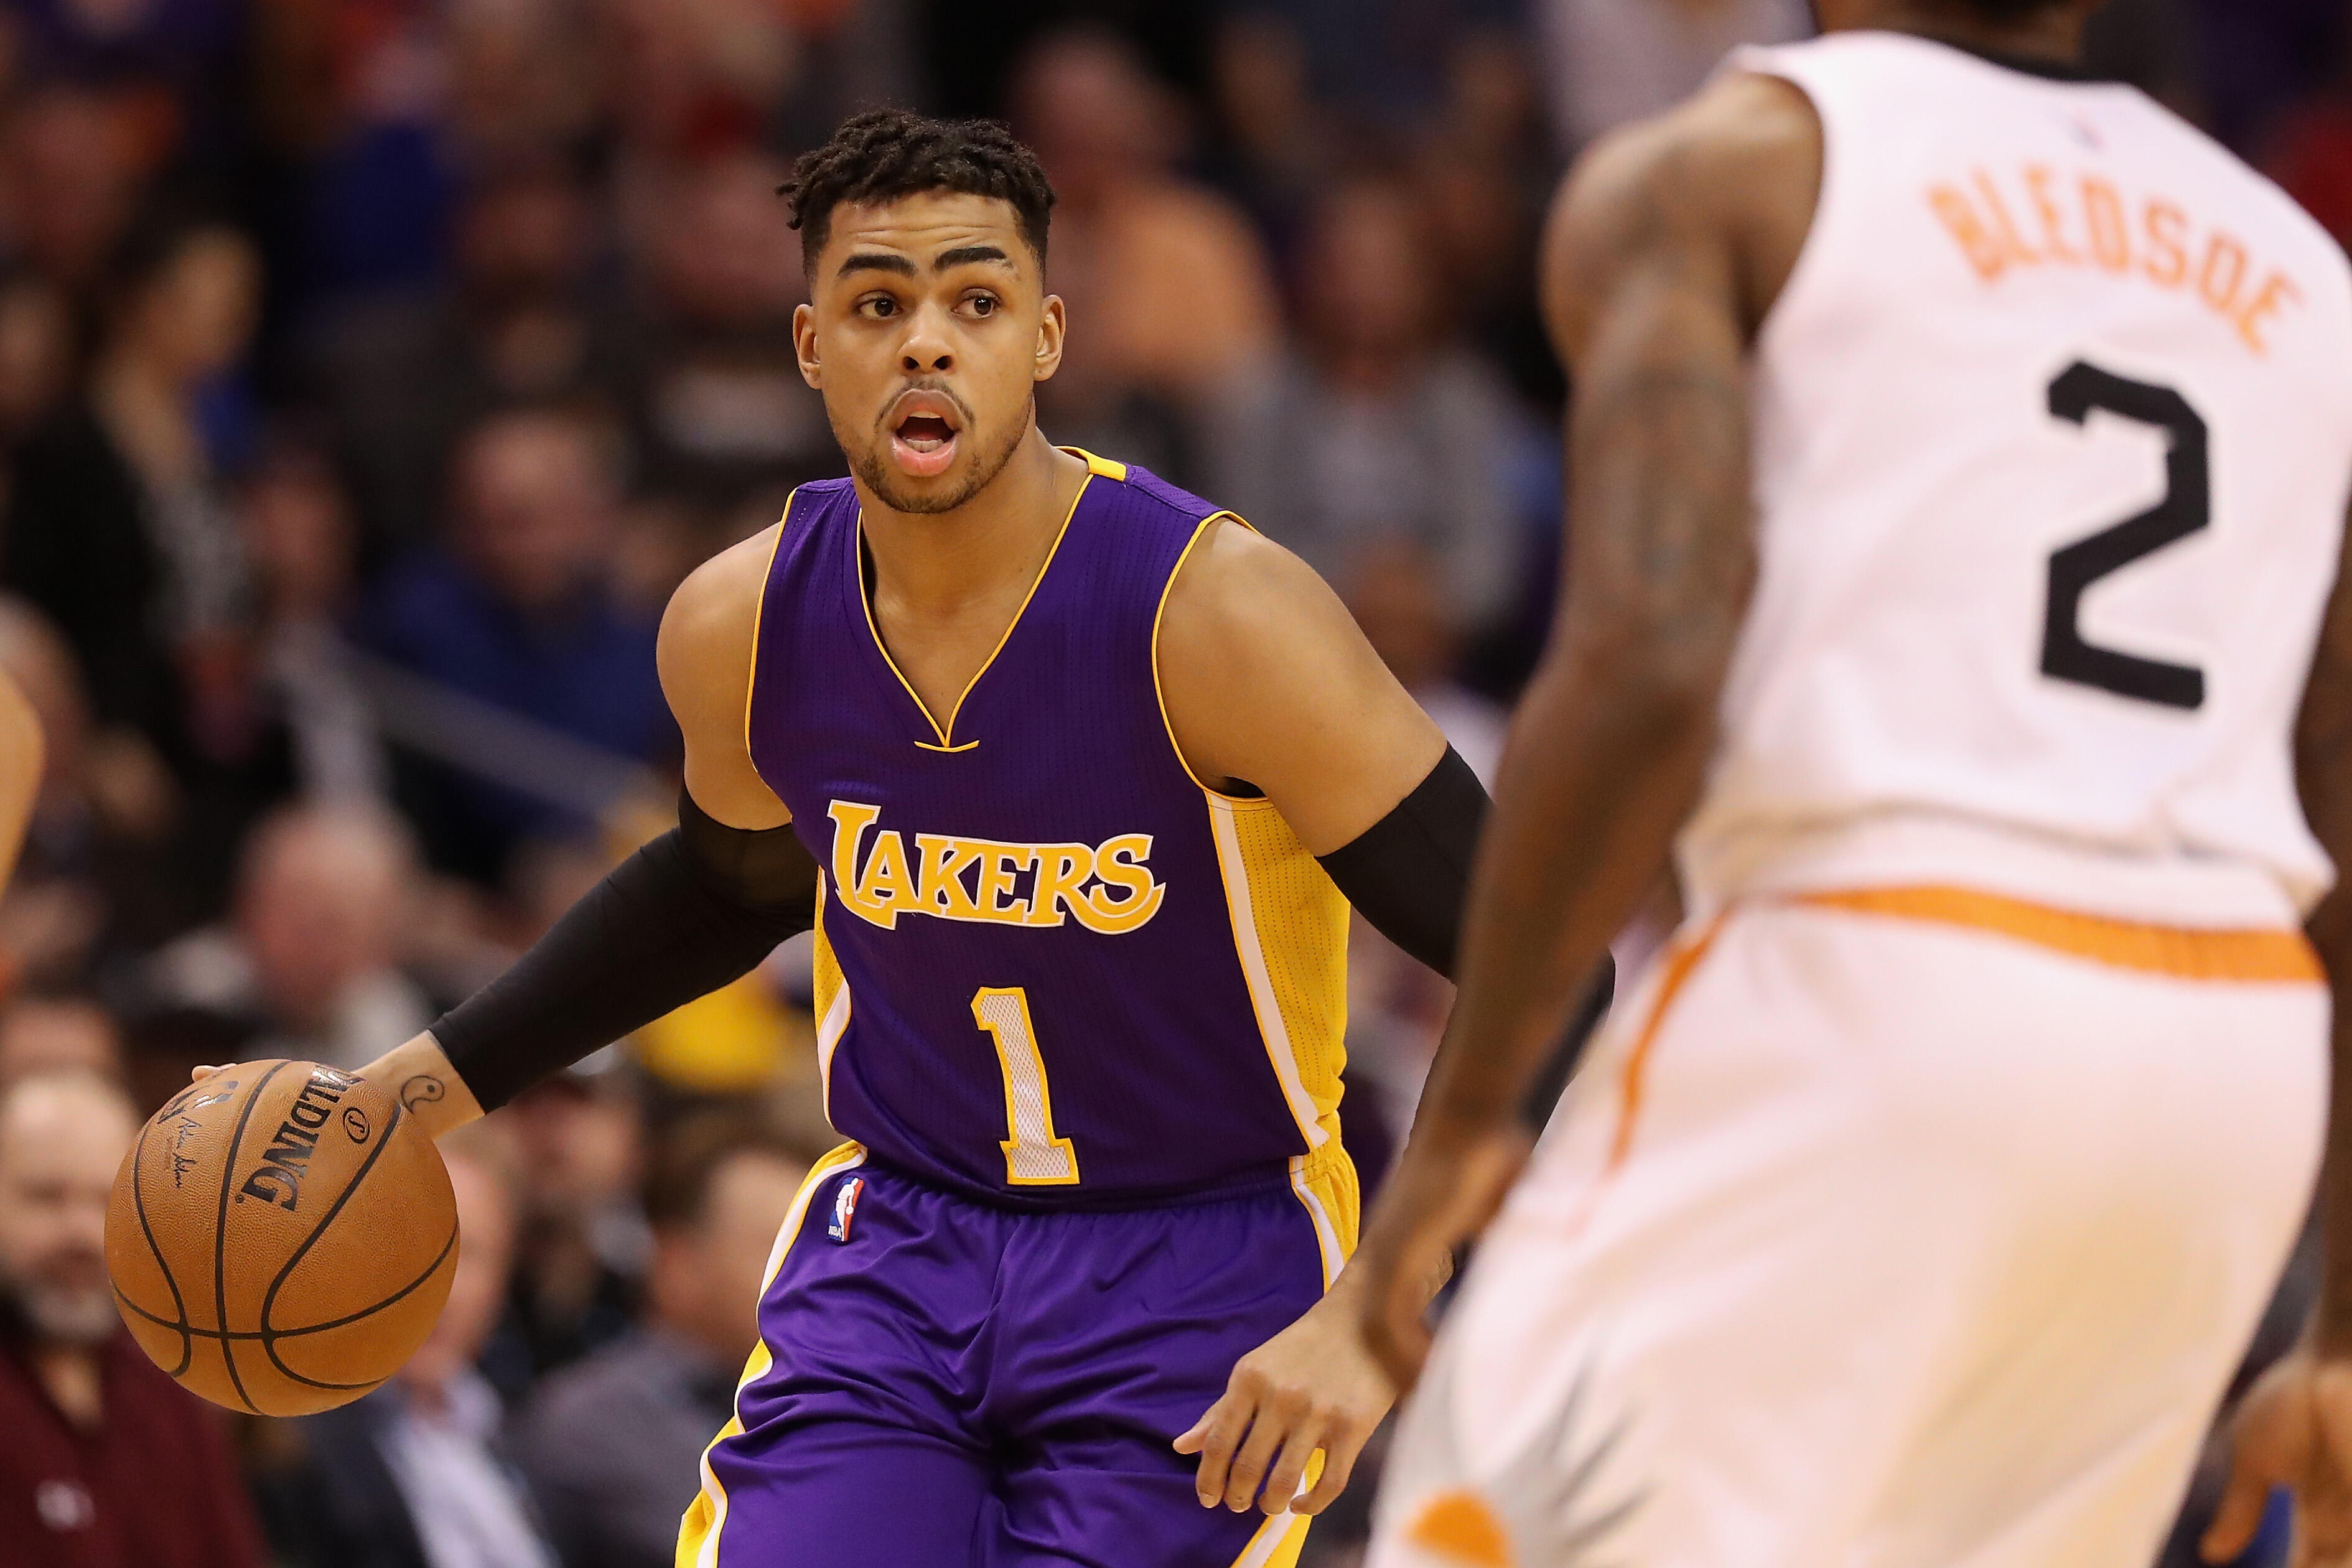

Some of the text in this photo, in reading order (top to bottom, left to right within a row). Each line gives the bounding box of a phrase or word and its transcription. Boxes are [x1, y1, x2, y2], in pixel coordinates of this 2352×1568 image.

[1927, 161, 2302, 355] BLEDSOE
[2042, 360, 2210, 709] 2
[827, 800, 1165, 934] LAKERS
[241, 1065, 366, 1211] PALDING
[971, 987, 1080, 1184] 1
[828, 1225, 841, 1238] NBA
